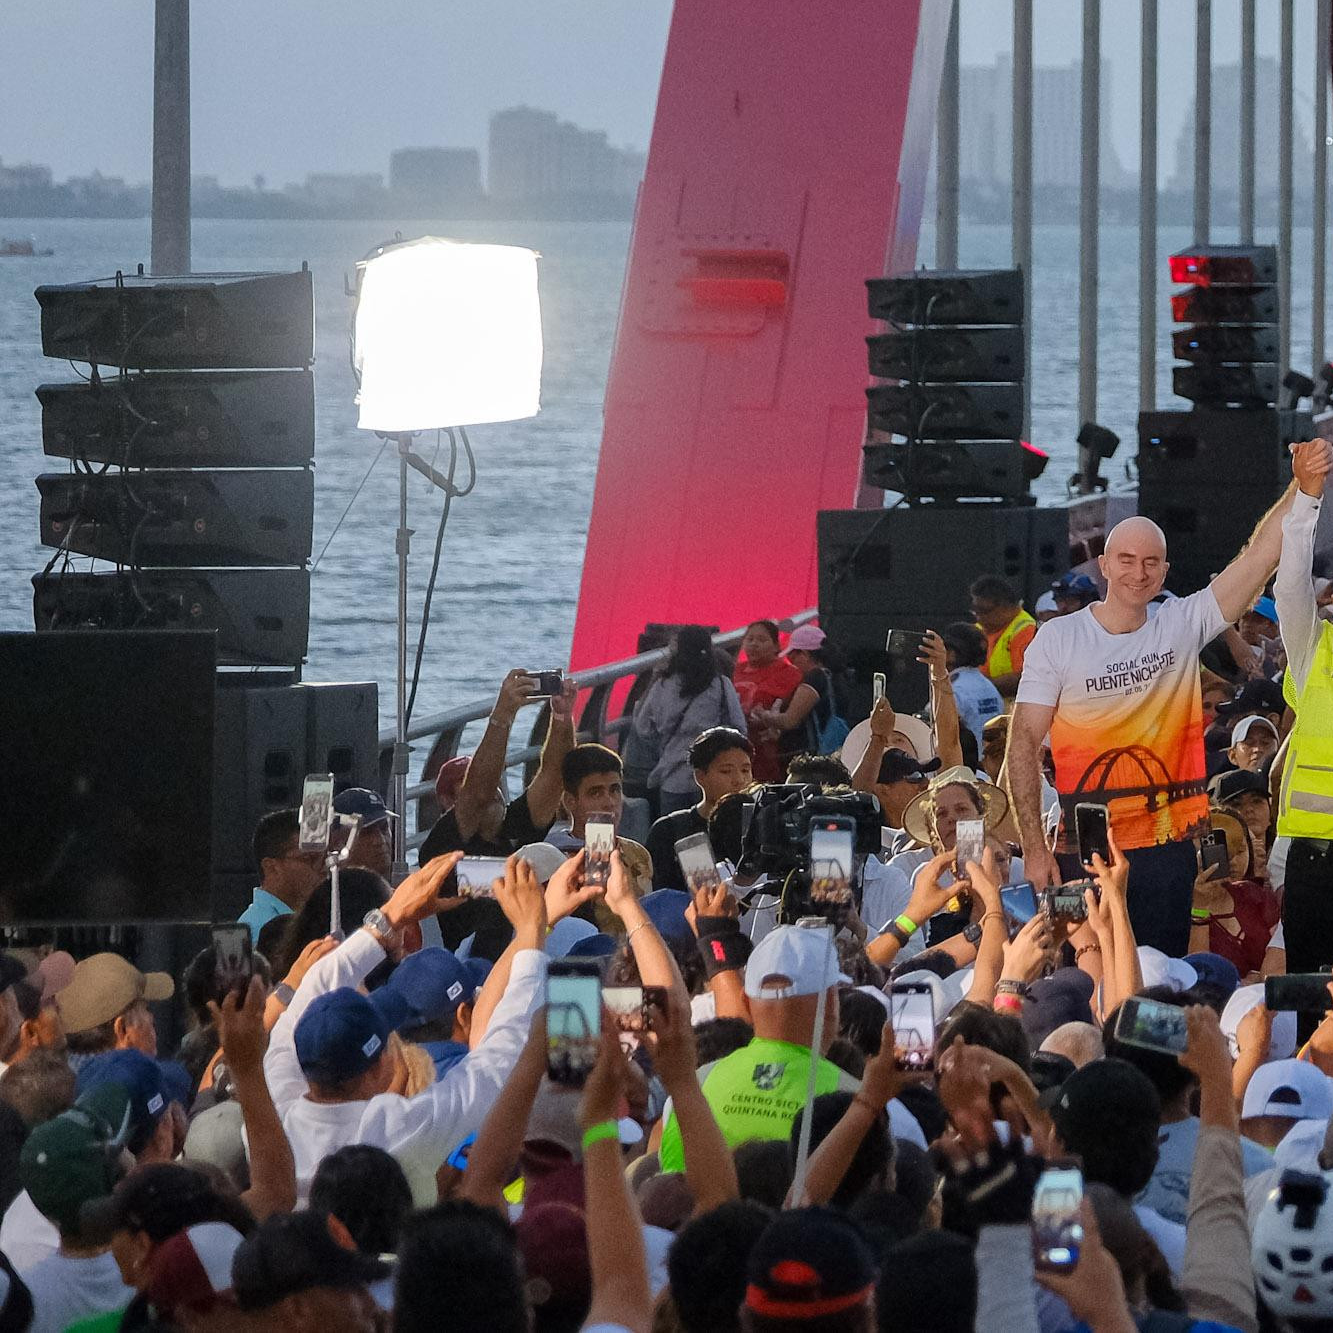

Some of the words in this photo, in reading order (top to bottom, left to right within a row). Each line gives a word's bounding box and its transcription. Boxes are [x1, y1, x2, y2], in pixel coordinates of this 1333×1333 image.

[1106, 659, 1140, 674] SOCIAL
[1141, 652, 1160, 665] RUN
[1085, 671, 1130, 693] PUENTE
